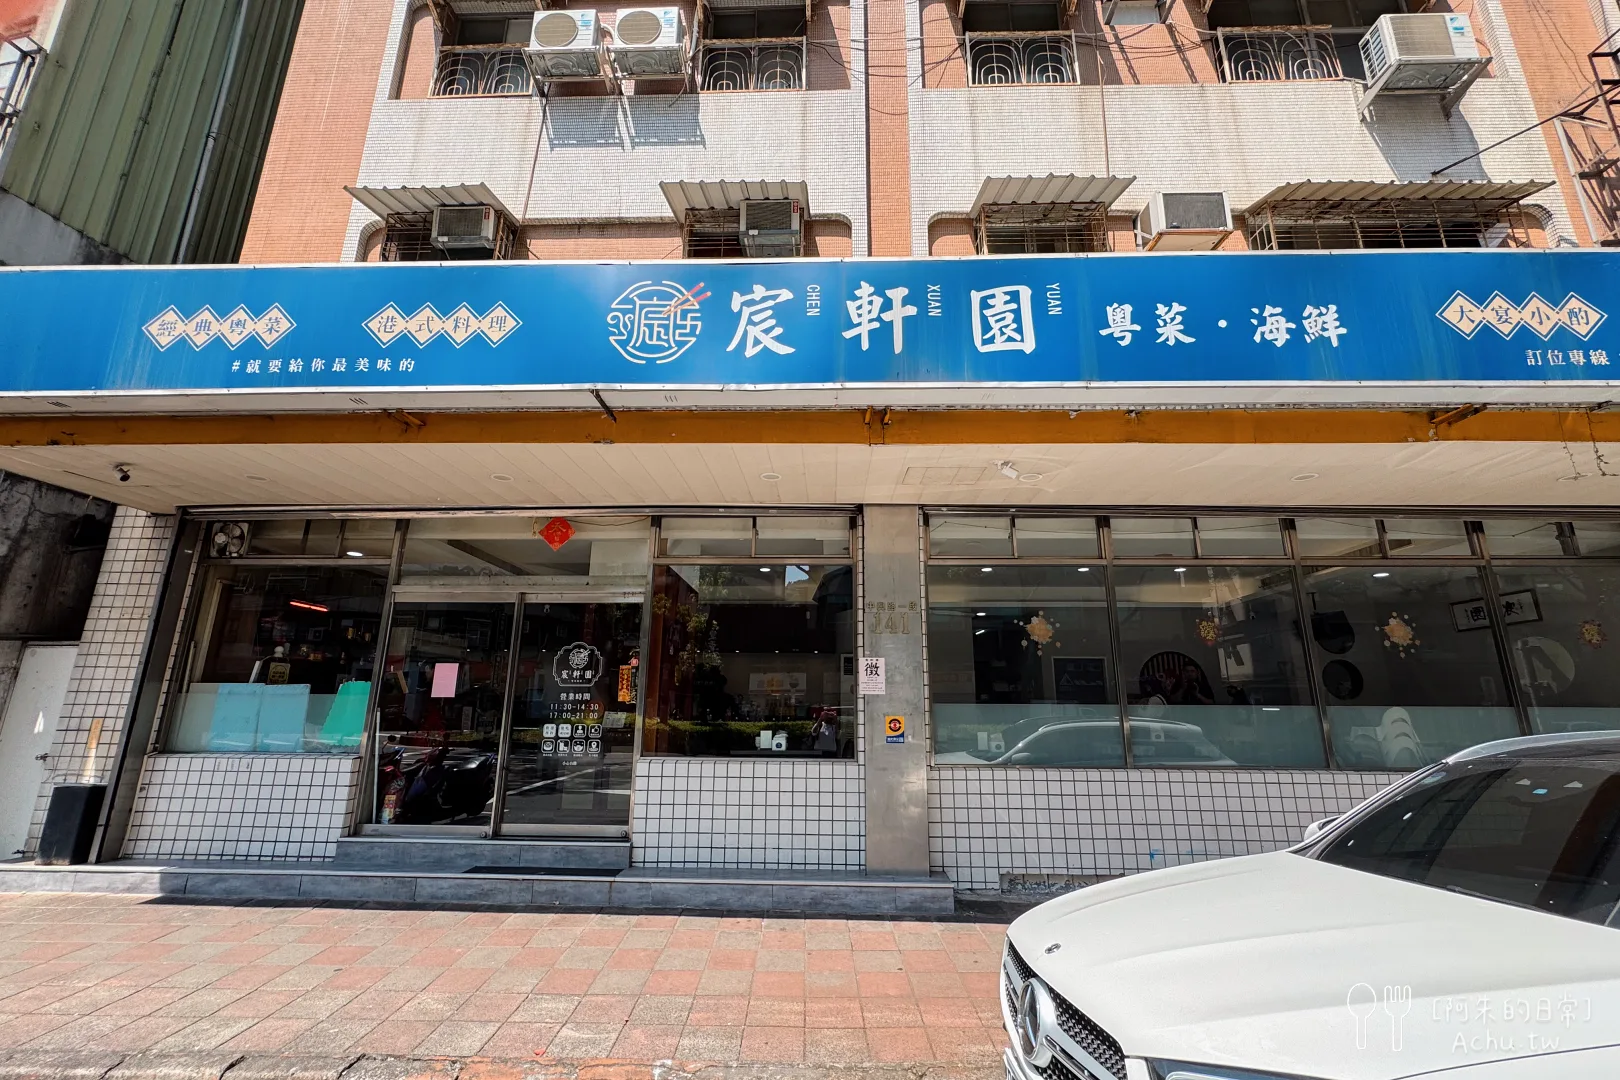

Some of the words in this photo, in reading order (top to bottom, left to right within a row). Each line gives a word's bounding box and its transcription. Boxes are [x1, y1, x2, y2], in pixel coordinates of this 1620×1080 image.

[806, 284, 821, 317] CHEN
[926, 284, 942, 317] XUAN
[1046, 282, 1062, 316] YUAN
[377, 315, 507, 334] 港式料理
[726, 280, 1036, 357] 宸軒園
[1453, 304, 1590, 326] 大宴小酌
[155, 316, 283, 337] 經典粵菜
[1525, 349, 1610, 366] 訂位專線
[873, 612, 910, 635] 141
[864, 662, 880, 677] 徵
[549, 711, 598, 719] 17:00-21:00
